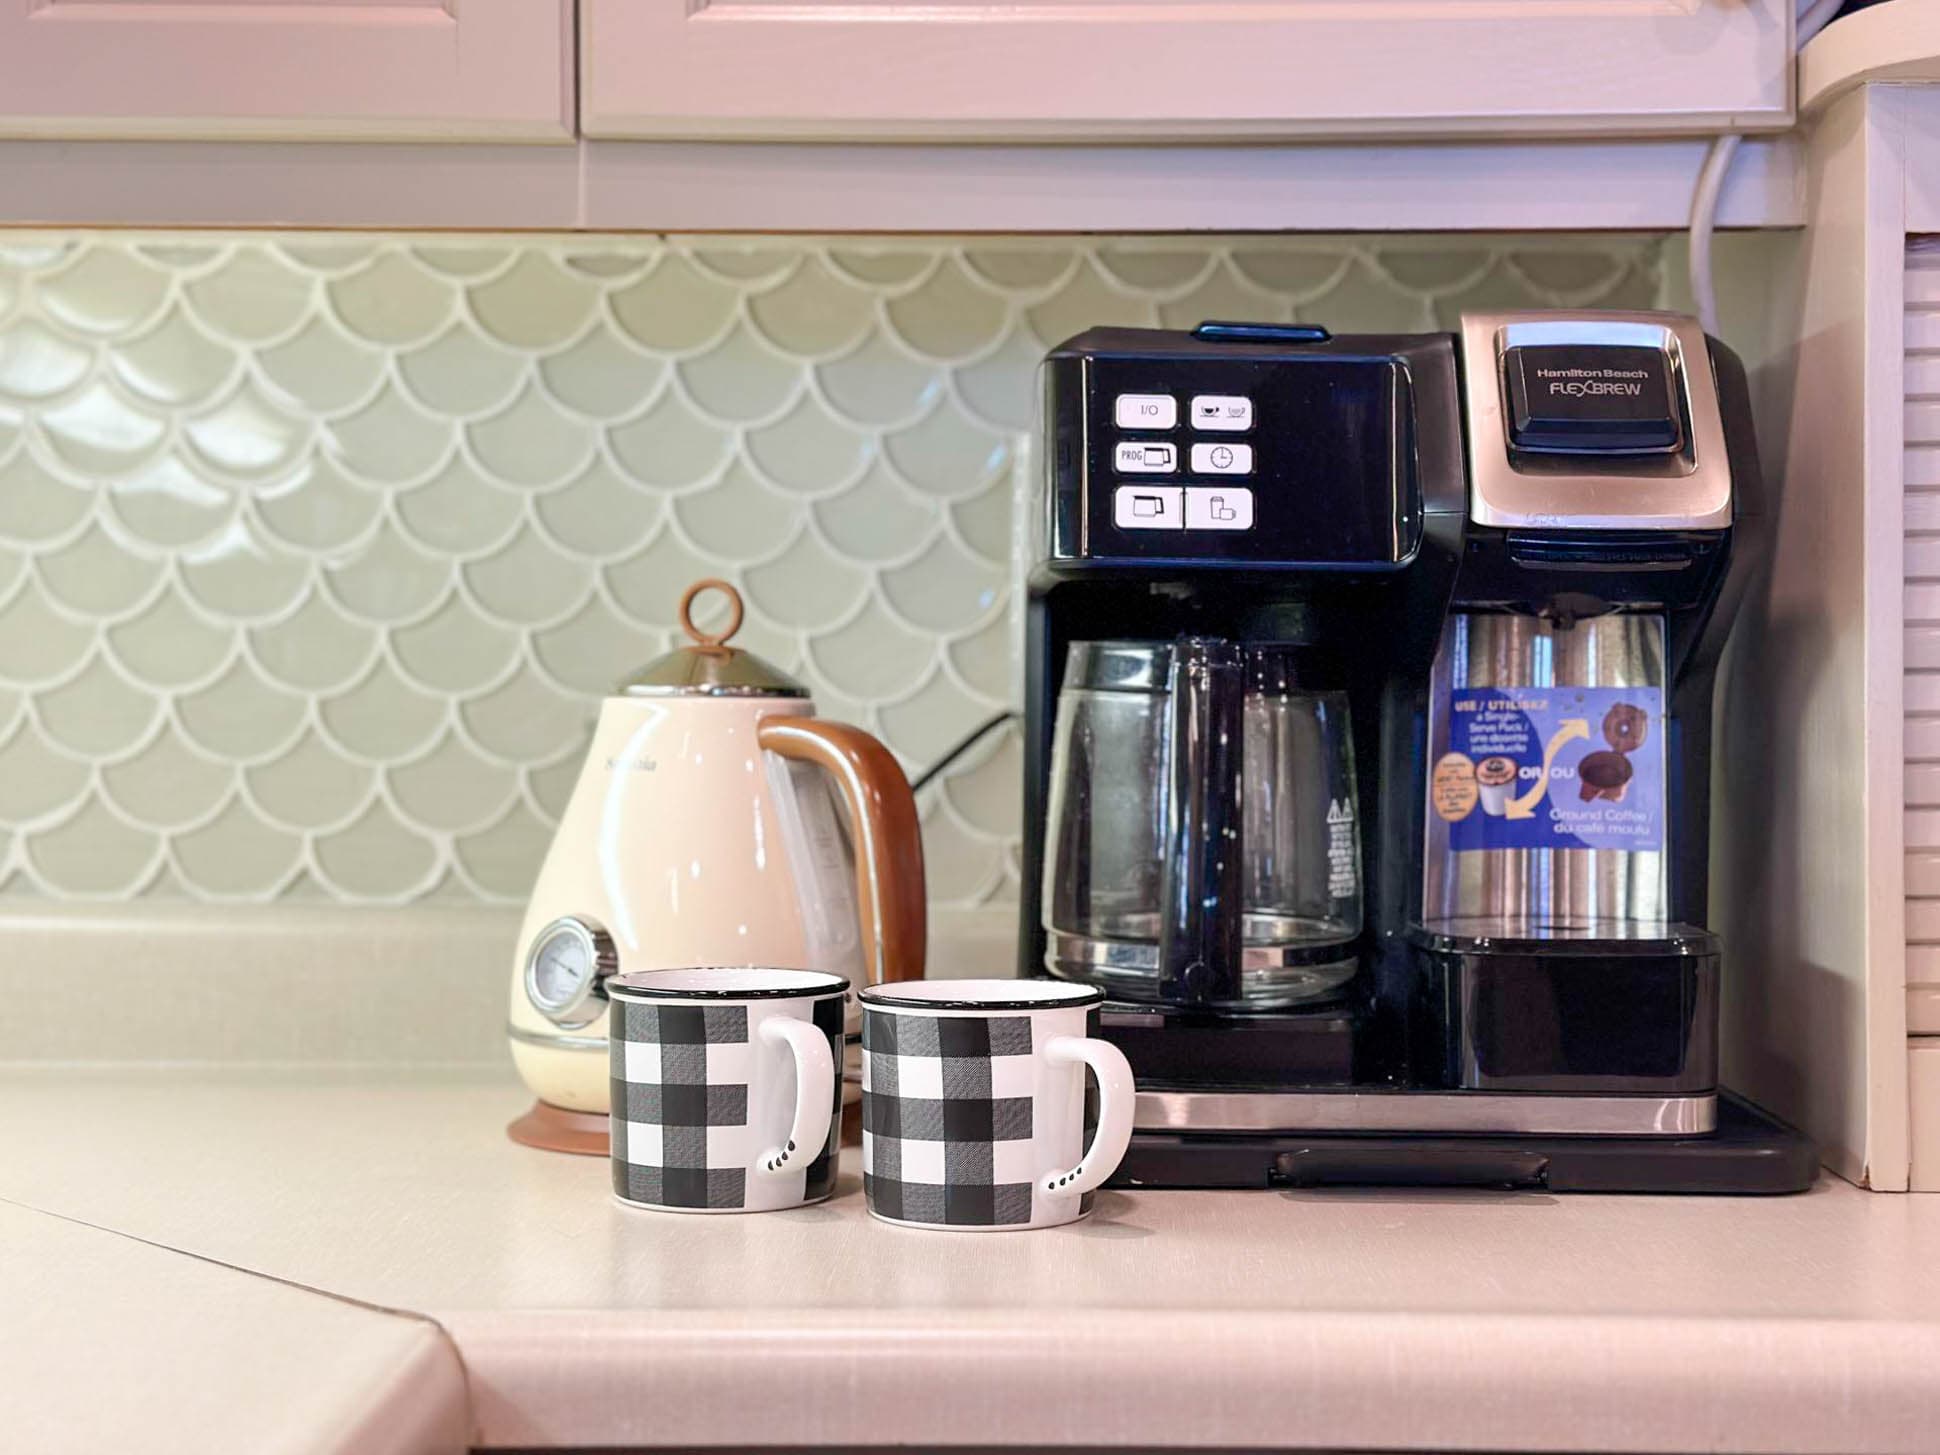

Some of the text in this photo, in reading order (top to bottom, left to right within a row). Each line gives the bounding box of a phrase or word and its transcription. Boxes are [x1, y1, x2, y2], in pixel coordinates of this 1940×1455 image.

[1537, 369, 1648, 378] Hamilton Beach
[1550, 380, 1641, 397] FLEXBREW
[1141, 405, 1158, 416] I/O
[1121, 450, 1142, 461] PROG
[1455, 700, 1476, 712] USE
[1519, 766, 1541, 779] OR
[1551, 767, 1575, 779] OU
[1549, 807, 1602, 821] Ground
[1605, 808, 1647, 821] Coffee
[1553, 823, 1573, 834] du
[1608, 823, 1650, 835] moulu
